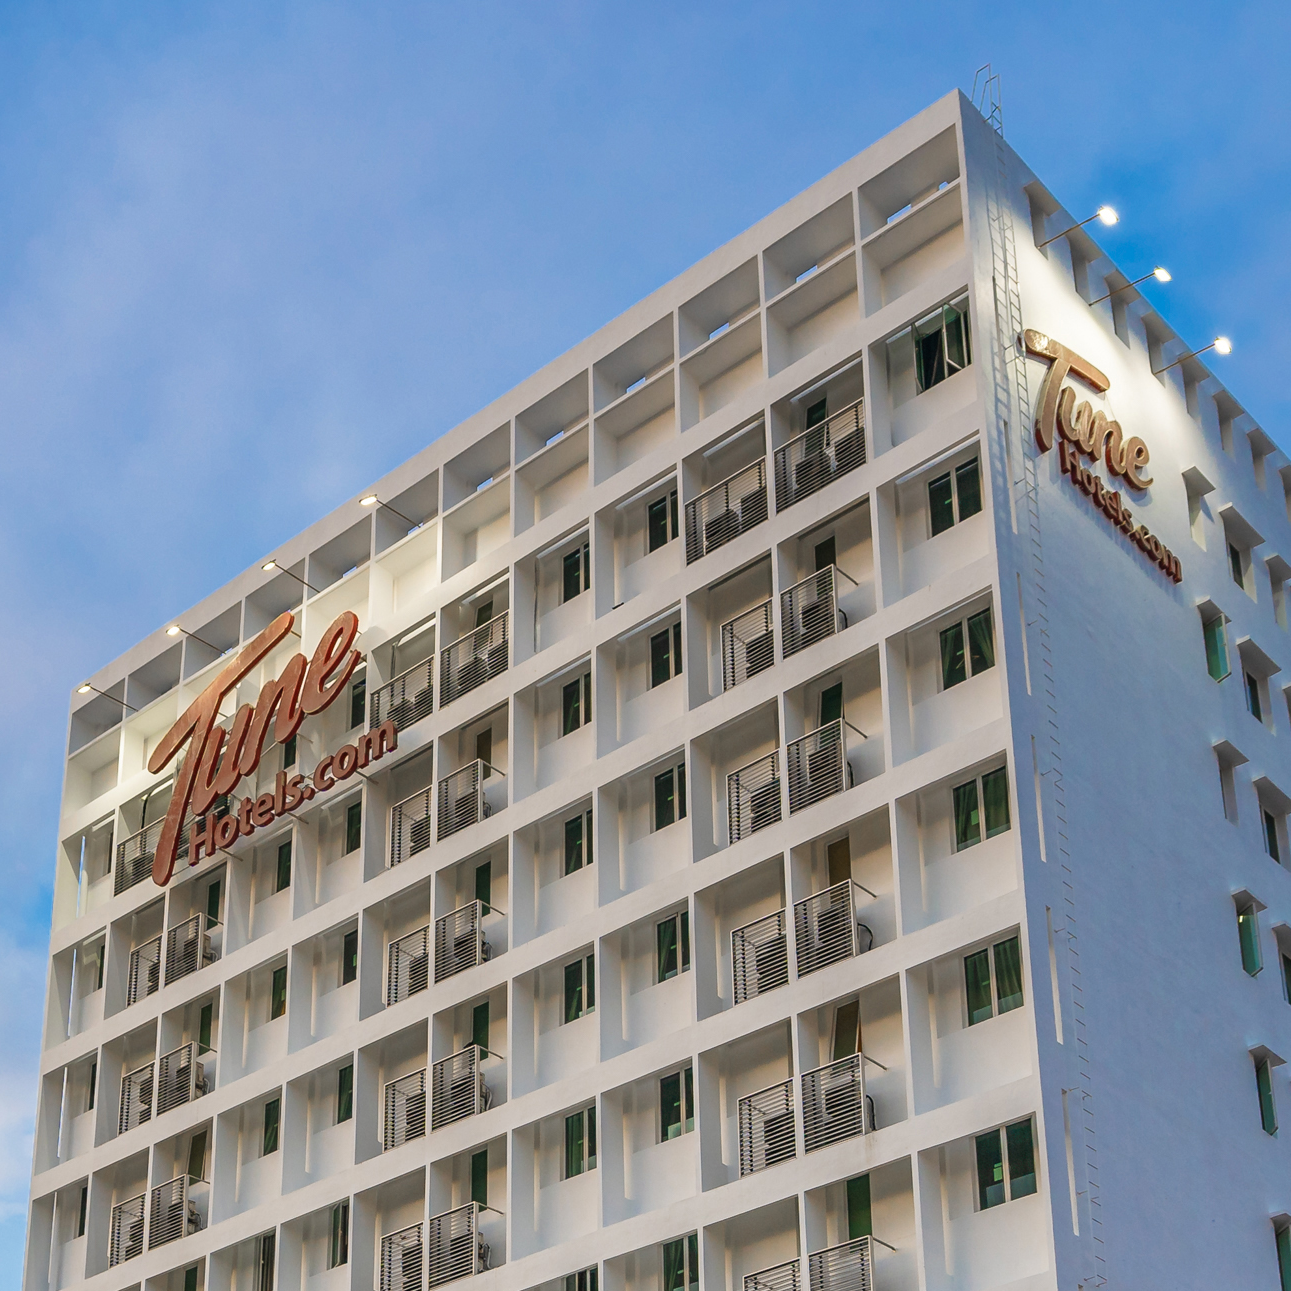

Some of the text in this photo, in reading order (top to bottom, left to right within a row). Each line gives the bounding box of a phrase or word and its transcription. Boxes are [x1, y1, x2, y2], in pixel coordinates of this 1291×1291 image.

[1018, 328, 1154, 491] Tune
[1058, 439, 1183, 584] Hotels.com
[148, 610, 362, 887] Tune
[188, 720, 399, 867] Hotels.com
